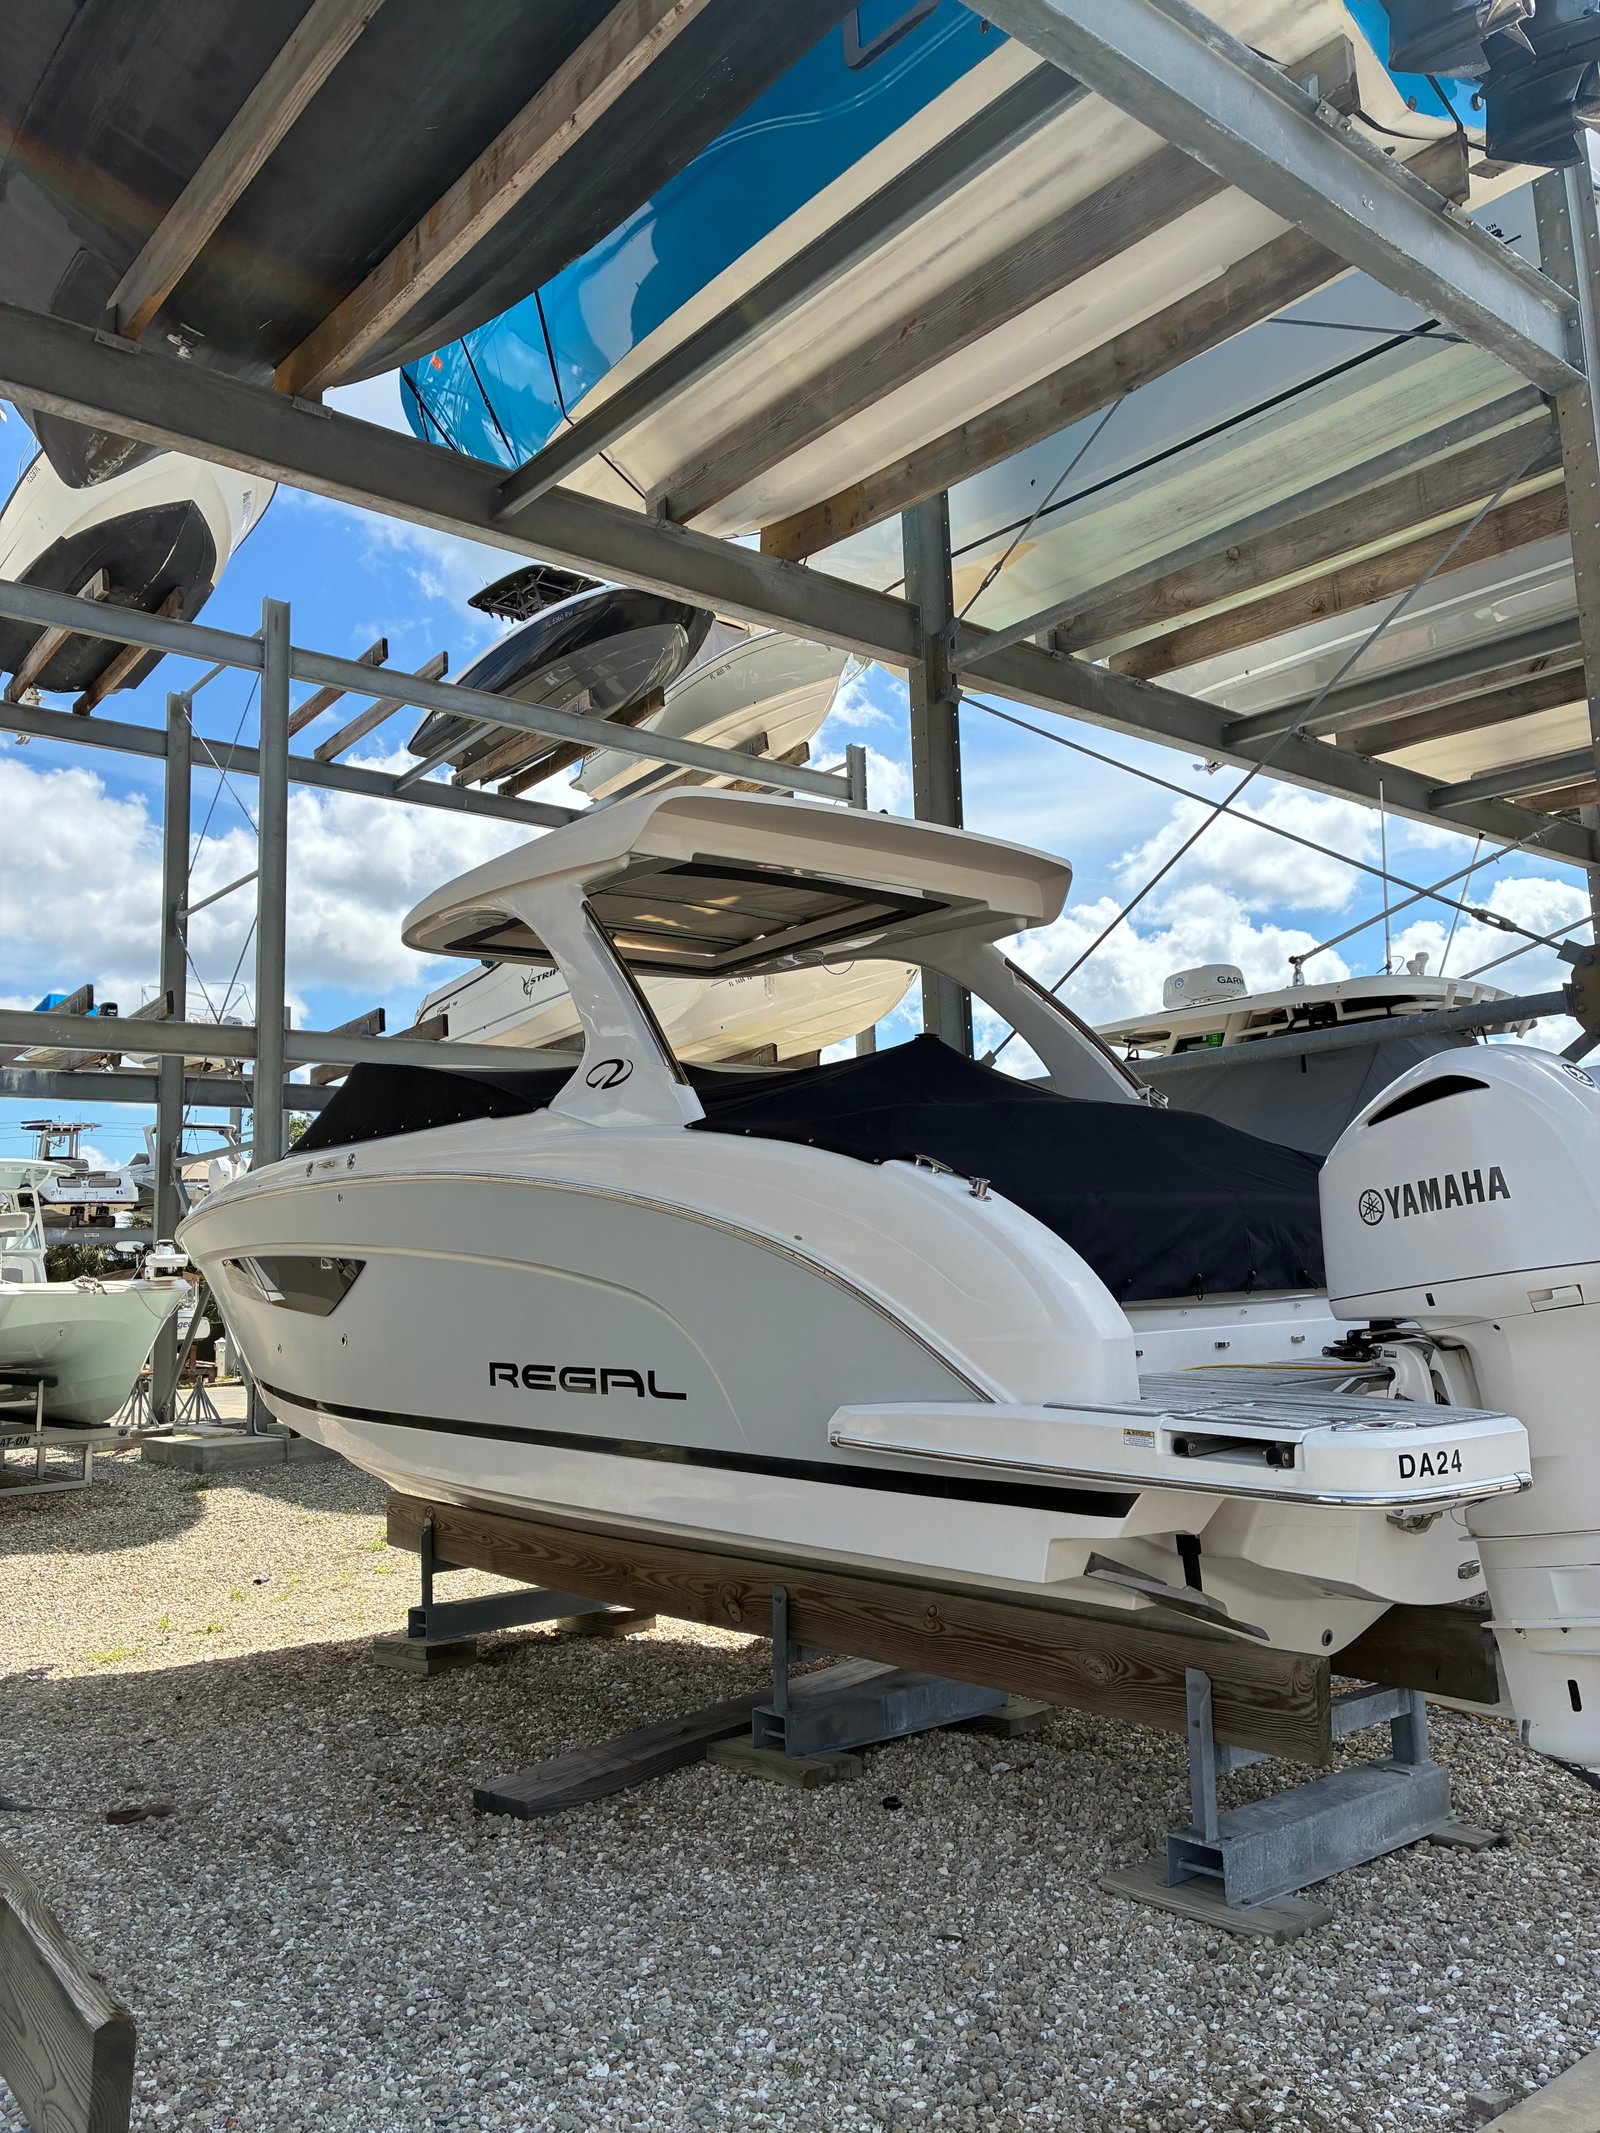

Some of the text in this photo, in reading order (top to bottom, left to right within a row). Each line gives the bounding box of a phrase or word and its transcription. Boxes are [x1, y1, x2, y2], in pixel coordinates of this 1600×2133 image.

[530, 968, 562, 985] STRIP
[1384, 1166, 1512, 1219] YAMAHA
[488, 1361, 687, 1400] REGAL
[1398, 1449, 1462, 1479] DA24
